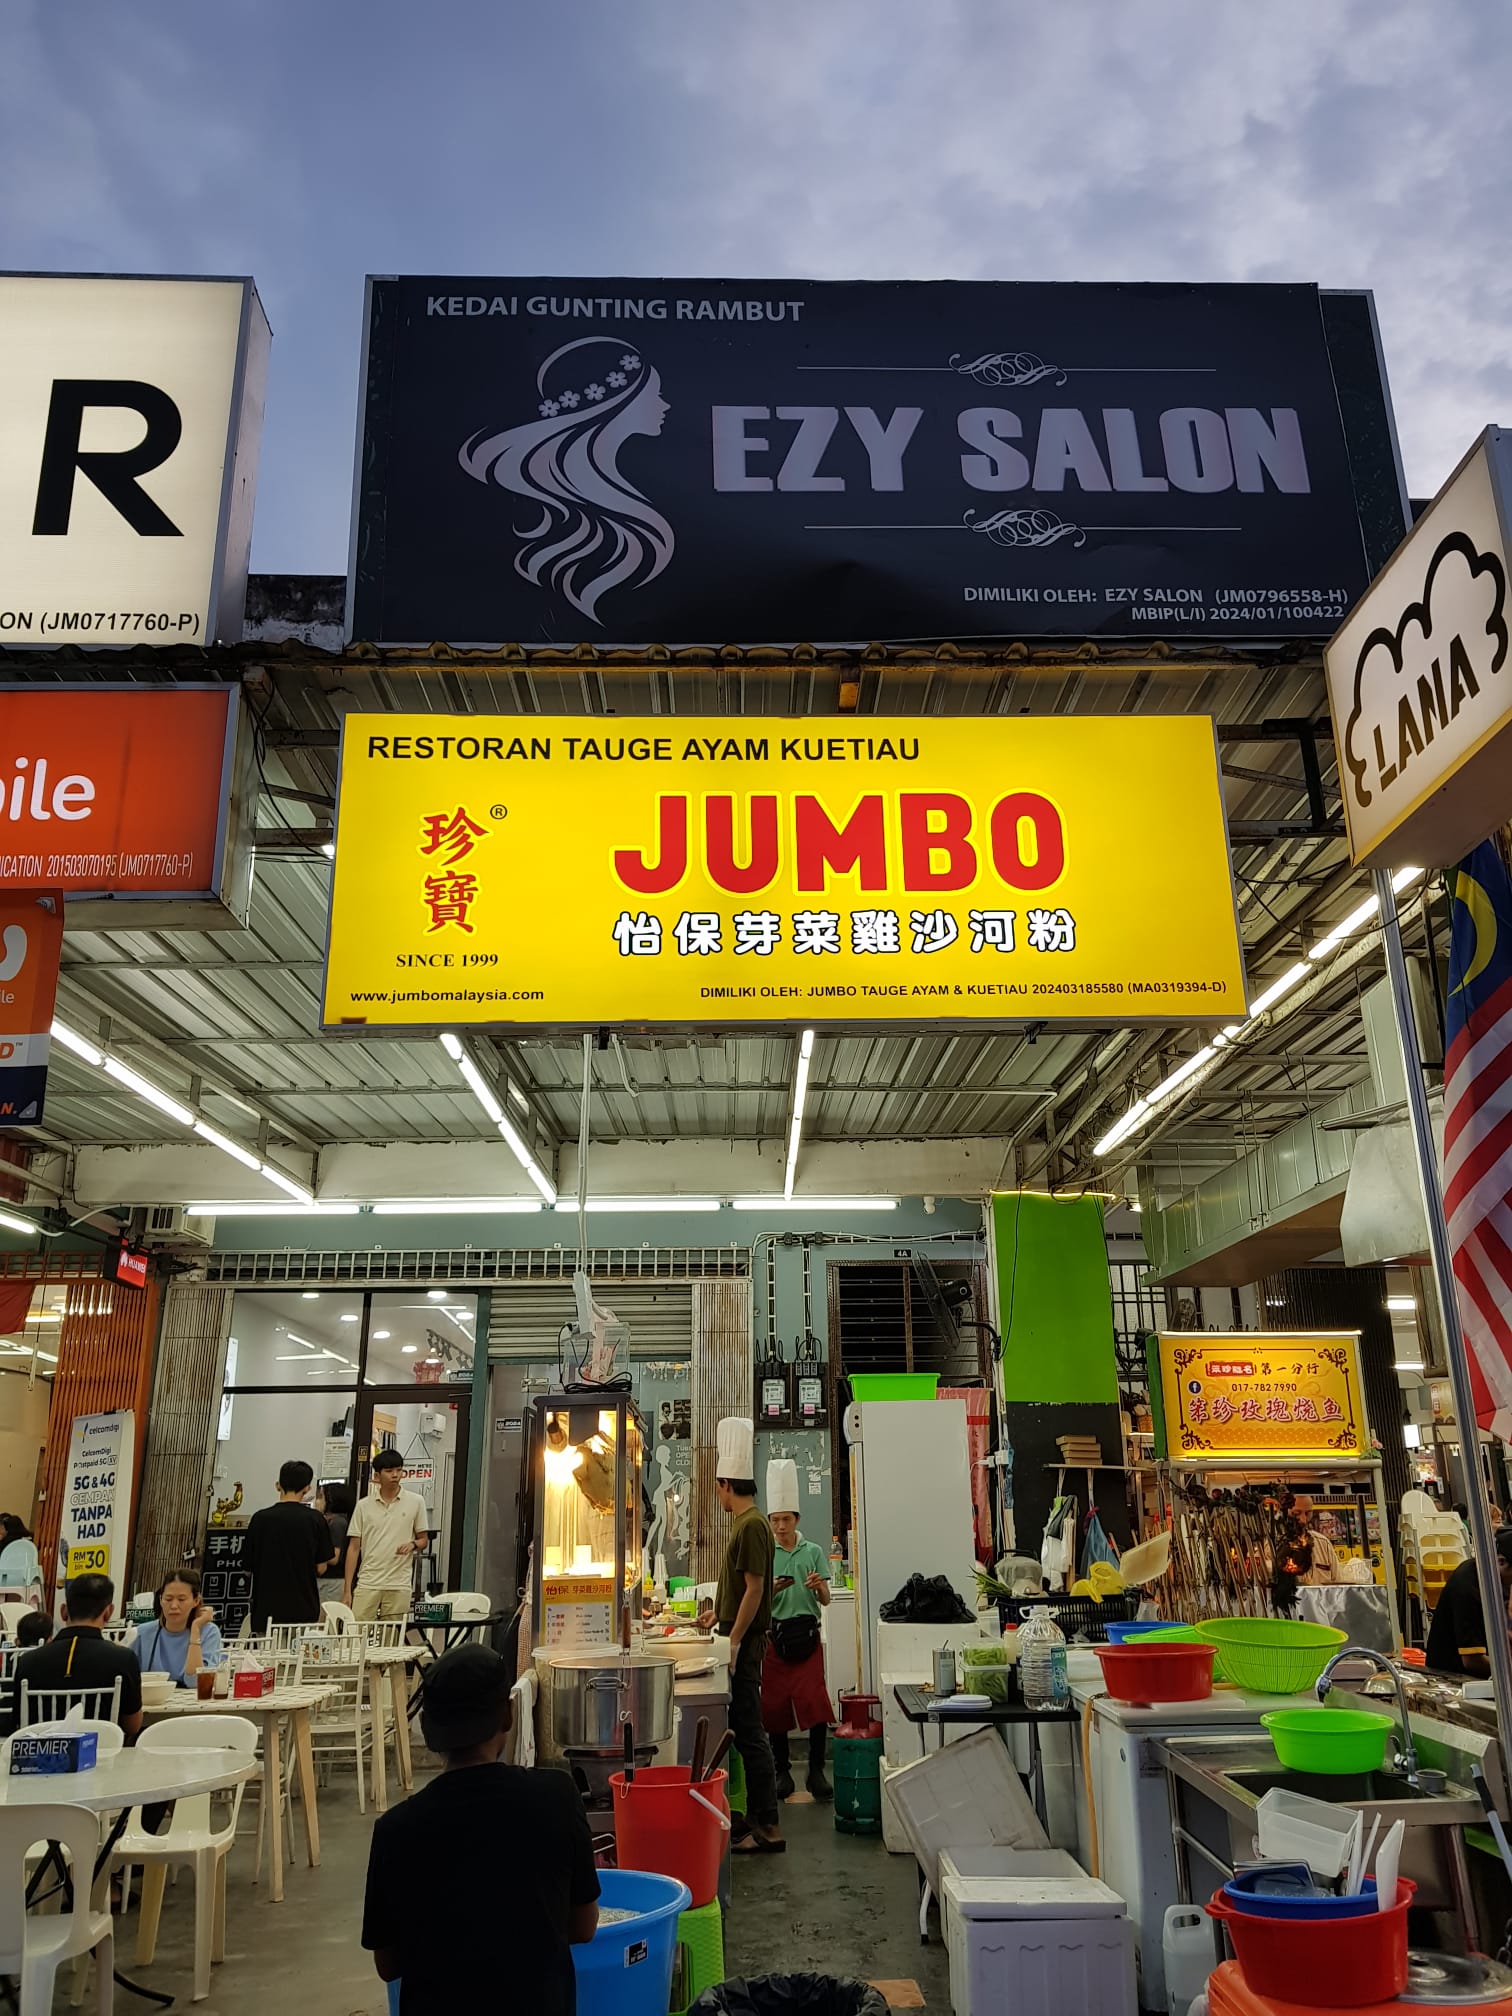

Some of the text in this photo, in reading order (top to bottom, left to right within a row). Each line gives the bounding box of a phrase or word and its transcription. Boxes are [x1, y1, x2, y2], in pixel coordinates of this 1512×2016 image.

[427, 296, 805, 322] KEDAI GUNTING RAMBUT
[32, 379, 185, 537] R
[711, 405, 1312, 494] EZY SALON
[964, 587, 1348, 605] DIMILIKI OLEH: EZY SALON (JM0796558-H)
[1131, 605, 1344, 622] MBIP(L/I) 2024/01/100422
[40, 612, 200, 636] (JM0717760-P)
[1373, 633, 1480, 792] LANA
[368, 736, 920, 761] RESTORAN TAUGE AYAM KUETIAU
[0, 757, 96, 821] ile
[614, 791, 1065, 894] JUMBO
[0, 851, 194, 879] ICATION 201503070195 (JM0717760-P)
[419, 806, 490, 934] 珍寶
[613, 909, 1076, 955] 怡保芽菜雞沙河粉
[396, 954, 498, 968] SINCE 1999
[0, 988, 15, 1005] le
[350, 989, 544, 1004] www.jumbomalaysia.com
[700, 981, 1226, 998] DIMILIKI OLEH: JUMBO TAUGE AYAM & KUETIAU 202403185580 (MA0319394-D)
[1260, 1362, 1320, 1376] 第一分行
[1231, 1383, 1297, 1392] 017-782 7990
[82, 1446, 111, 1457] CelcomDigi
[73, 1472, 115, 1491] 5G & 4G
[401, 1469, 432, 1478] OPEN
[71, 1504, 112, 1522] TANPA
[77, 1523, 106, 1540] HAD
[74, 1549, 105, 1569] RM 30
[126, 1609, 155, 1618] PREMIER
[415, 1604, 445, 1613] PREMIER
[12, 1740, 69, 1755] PREMIER
